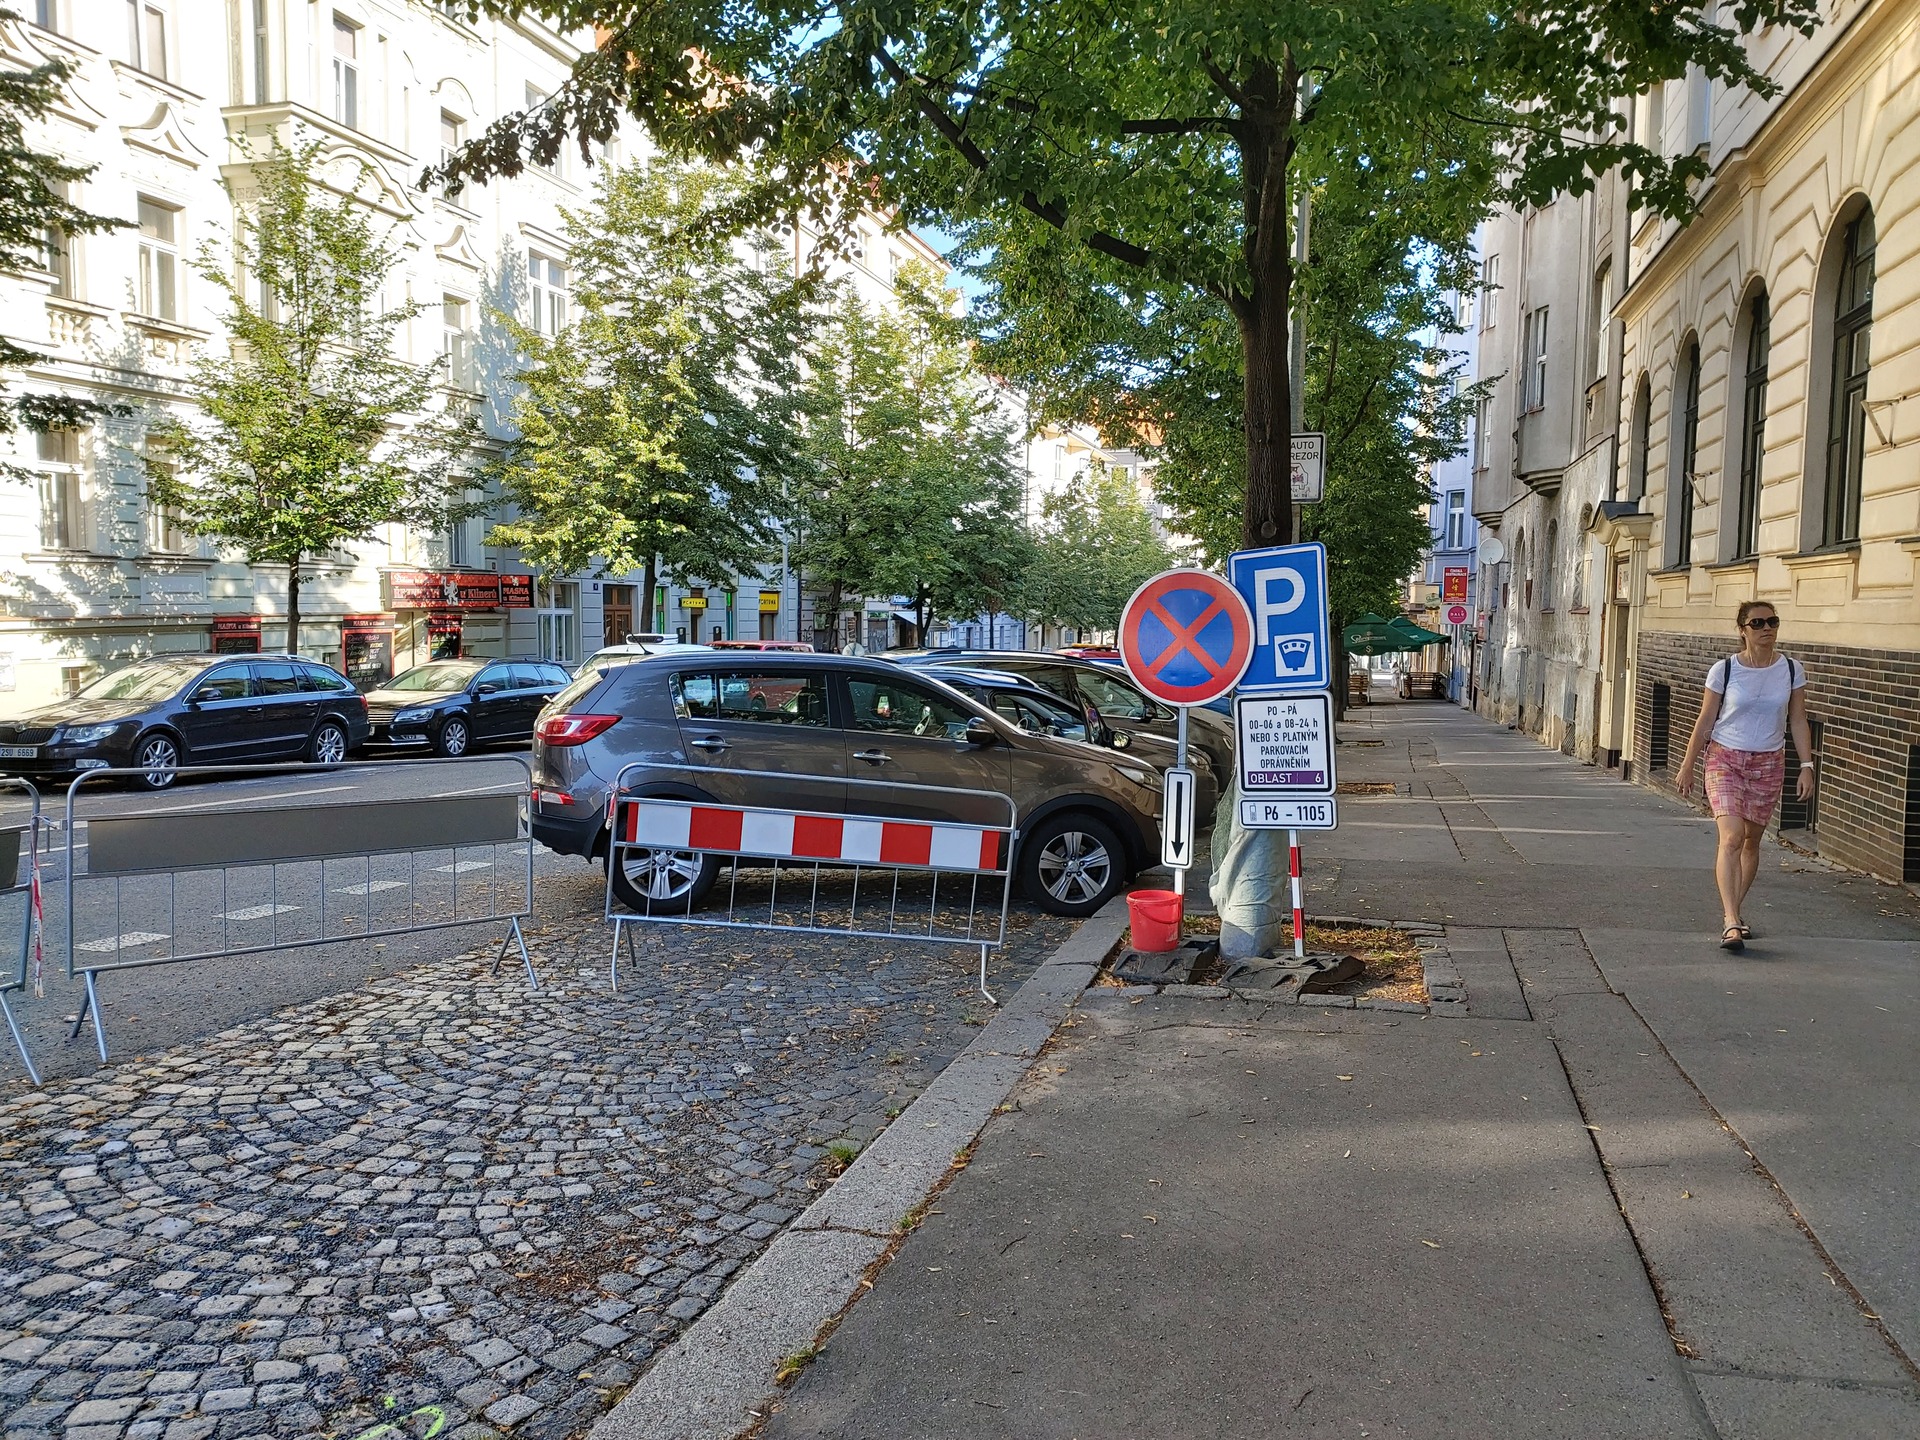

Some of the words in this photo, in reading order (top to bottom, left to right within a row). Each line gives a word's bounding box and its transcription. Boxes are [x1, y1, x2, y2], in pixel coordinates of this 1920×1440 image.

[1291, 441, 1314, 450] AUTO
[1291, 452, 1319, 460] REZOR
[1254, 567, 1306, 646] P
[1267, 706, 1278, 716] PO
[1287, 702, 1298, 715] PÁ
[1249, 720, 1273, 730] 00-06
[1276, 721, 1282, 729] a
[1284, 718, 1309, 729] 08-24
[1312, 718, 1318, 728] h
[1250, 732, 1271, 743] NEBO
[1273, 732, 1279, 742] S
[1282, 729, 1319, 742] PLATNÝM
[17, 748, 34, 757] 6669
[1260, 742, 1309, 756] PARKOVACÍM
[1260, 756, 1311, 769] OPRÁVNĚNÍM
[1250, 773, 1292, 783] OBLAST
[1315, 772, 1321, 783] 6
[1264, 805, 1279, 821] P6
[1296, 805, 1325, 821] 1105
